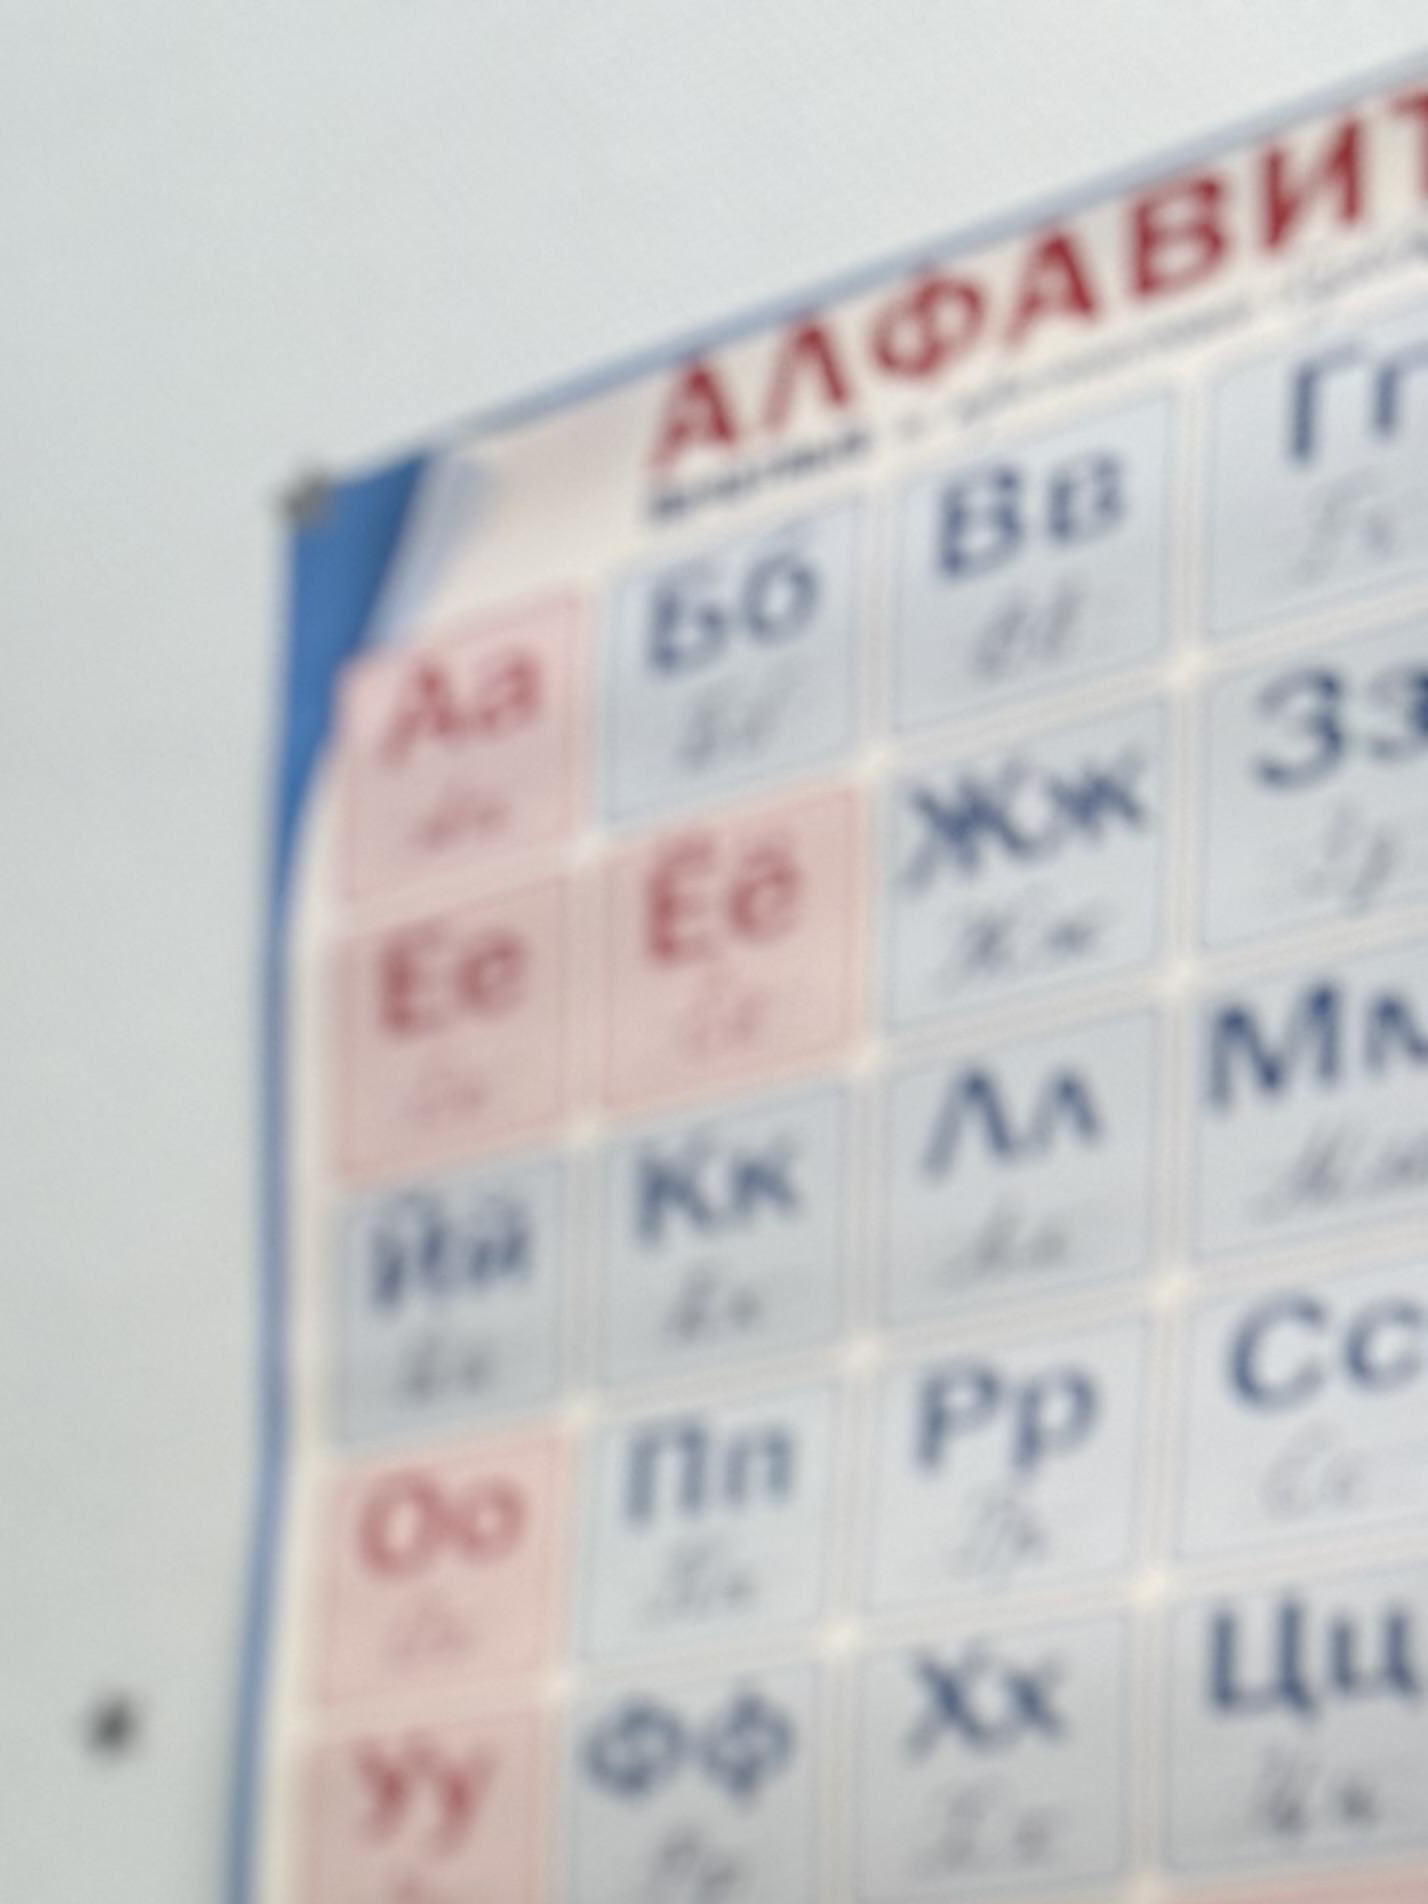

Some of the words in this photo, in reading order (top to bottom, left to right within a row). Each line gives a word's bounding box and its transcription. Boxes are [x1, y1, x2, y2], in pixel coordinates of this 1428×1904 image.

[932, 452, 1128, 586] Вв
[644, 545, 822, 682] Бб
[380, 642, 540, 765] Аа
[1254, 662, 1428, 790] Зз
[906, 756, 1146, 890] Жж
[376, 926, 528, 1040] Ее
[922, 1062, 1104, 1180] Лл
[632, 1142, 800, 1250] Кк
[1224, 1294, 1426, 1410] Сс
[621, 1416, 798, 1526] Пп
[912, 1362, 1102, 1480] Рр
[354, 1470, 530, 1580] Оо
[904, 1648, 1066, 1760] Хх
[1204, 1598, 1428, 1720] Цц
[354, 1734, 494, 1855] Уу
[581, 1690, 796, 1804] Фф
